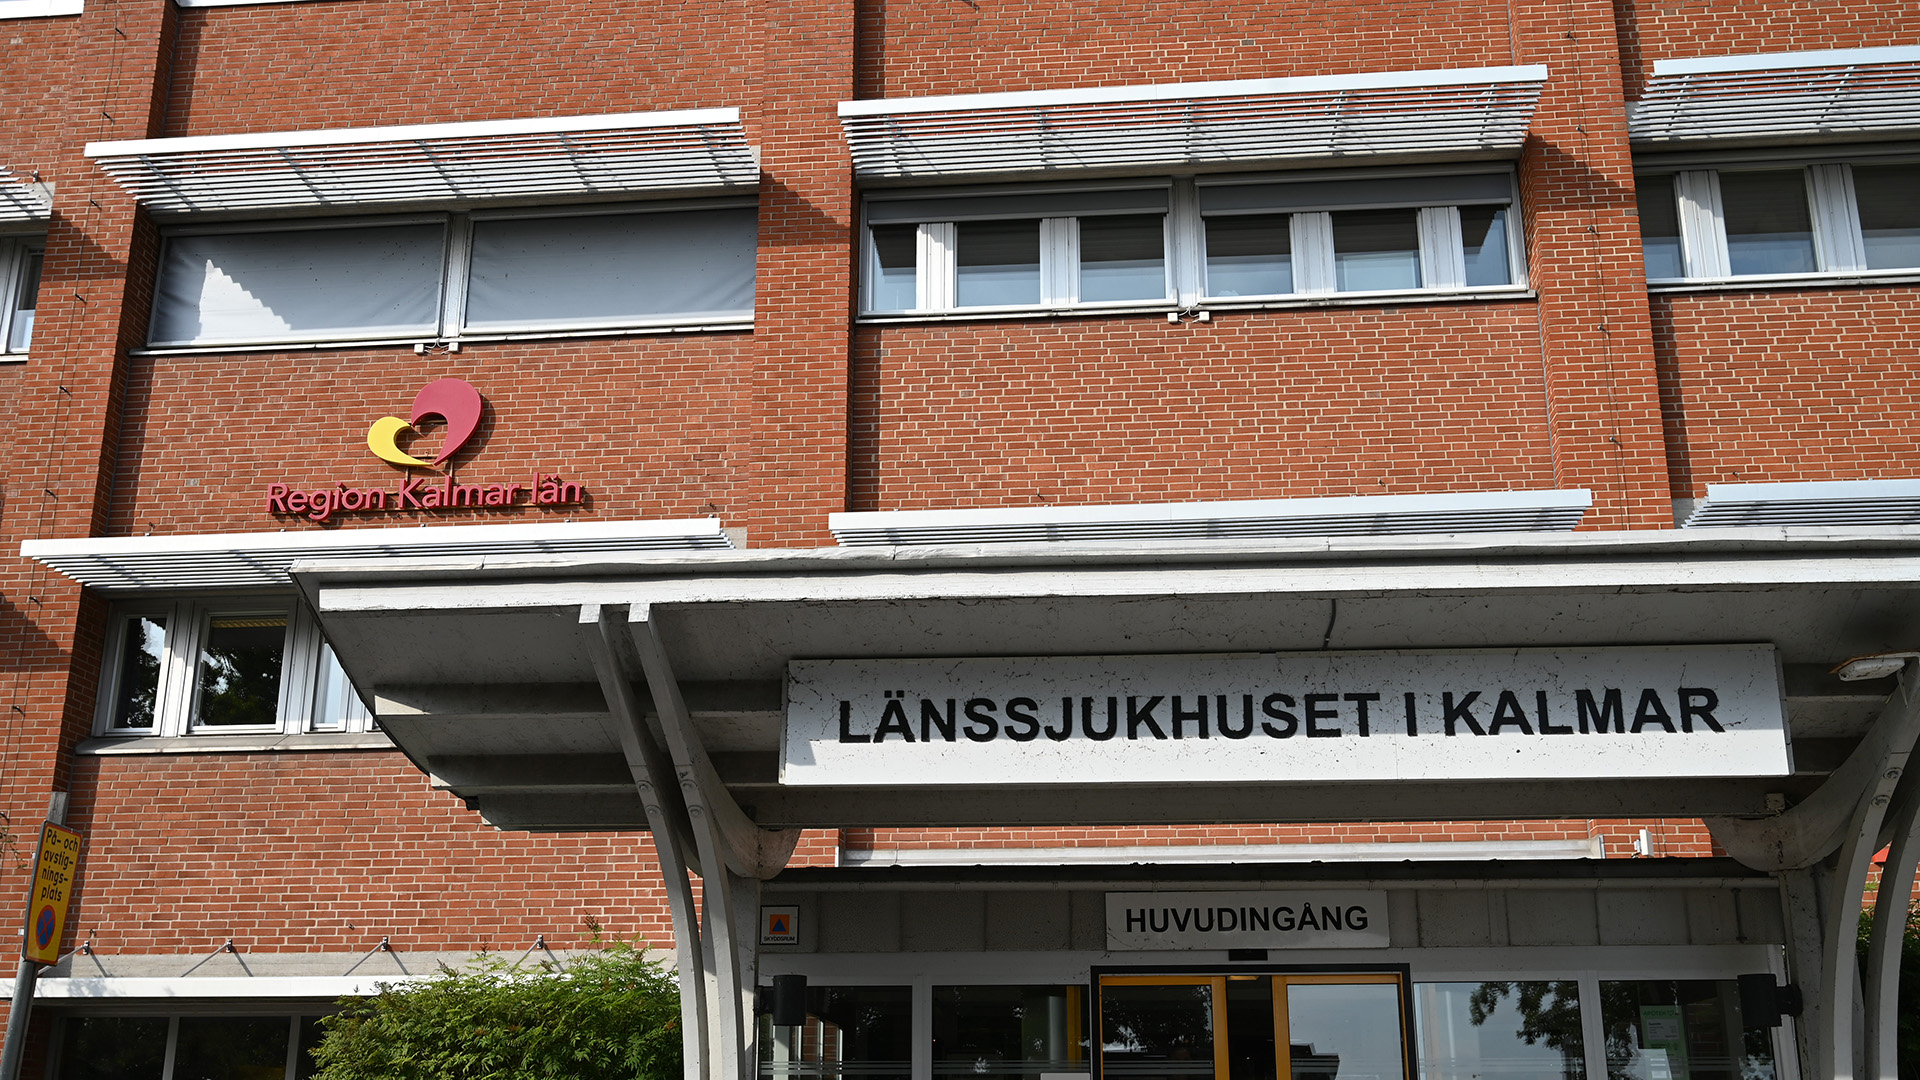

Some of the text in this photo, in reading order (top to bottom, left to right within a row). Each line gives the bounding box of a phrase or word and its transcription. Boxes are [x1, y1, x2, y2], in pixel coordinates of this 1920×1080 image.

[265, 472, 583, 522] Region Kalmar län
[838, 687, 1726, 743] LÄNSSJUKHUSET I KALMAR
[46, 829, 78, 852] På- och
[44, 850, 73, 870] avstig-
[41, 865, 68, 886] nings-
[41, 885, 62, 902] plats
[1126, 902, 1369, 932] HUVUDINGÅNG
